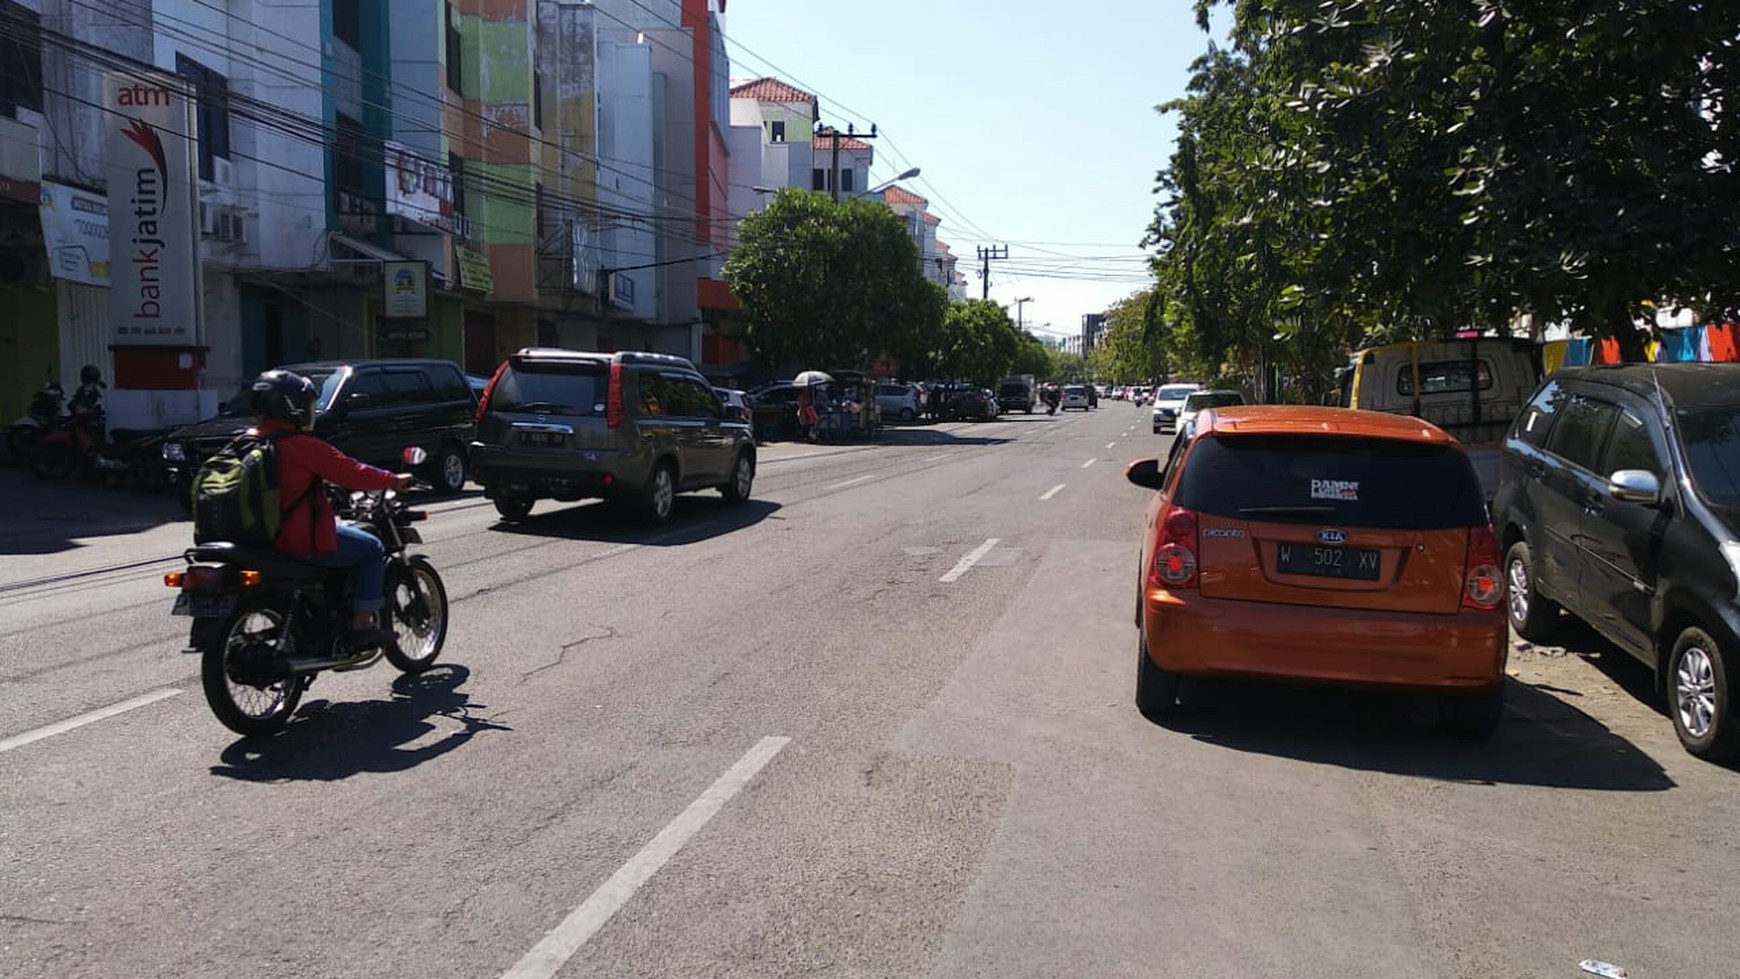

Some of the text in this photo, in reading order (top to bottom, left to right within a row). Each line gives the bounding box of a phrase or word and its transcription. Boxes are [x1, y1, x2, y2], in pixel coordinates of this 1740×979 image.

[118, 85, 170, 106] atm
[131, 168, 165, 318] bankjatim
[1203, 528, 1246, 538] picanto
[1322, 531, 1344, 541] KIA
[1281, 546, 1378, 569] W 502 XV
